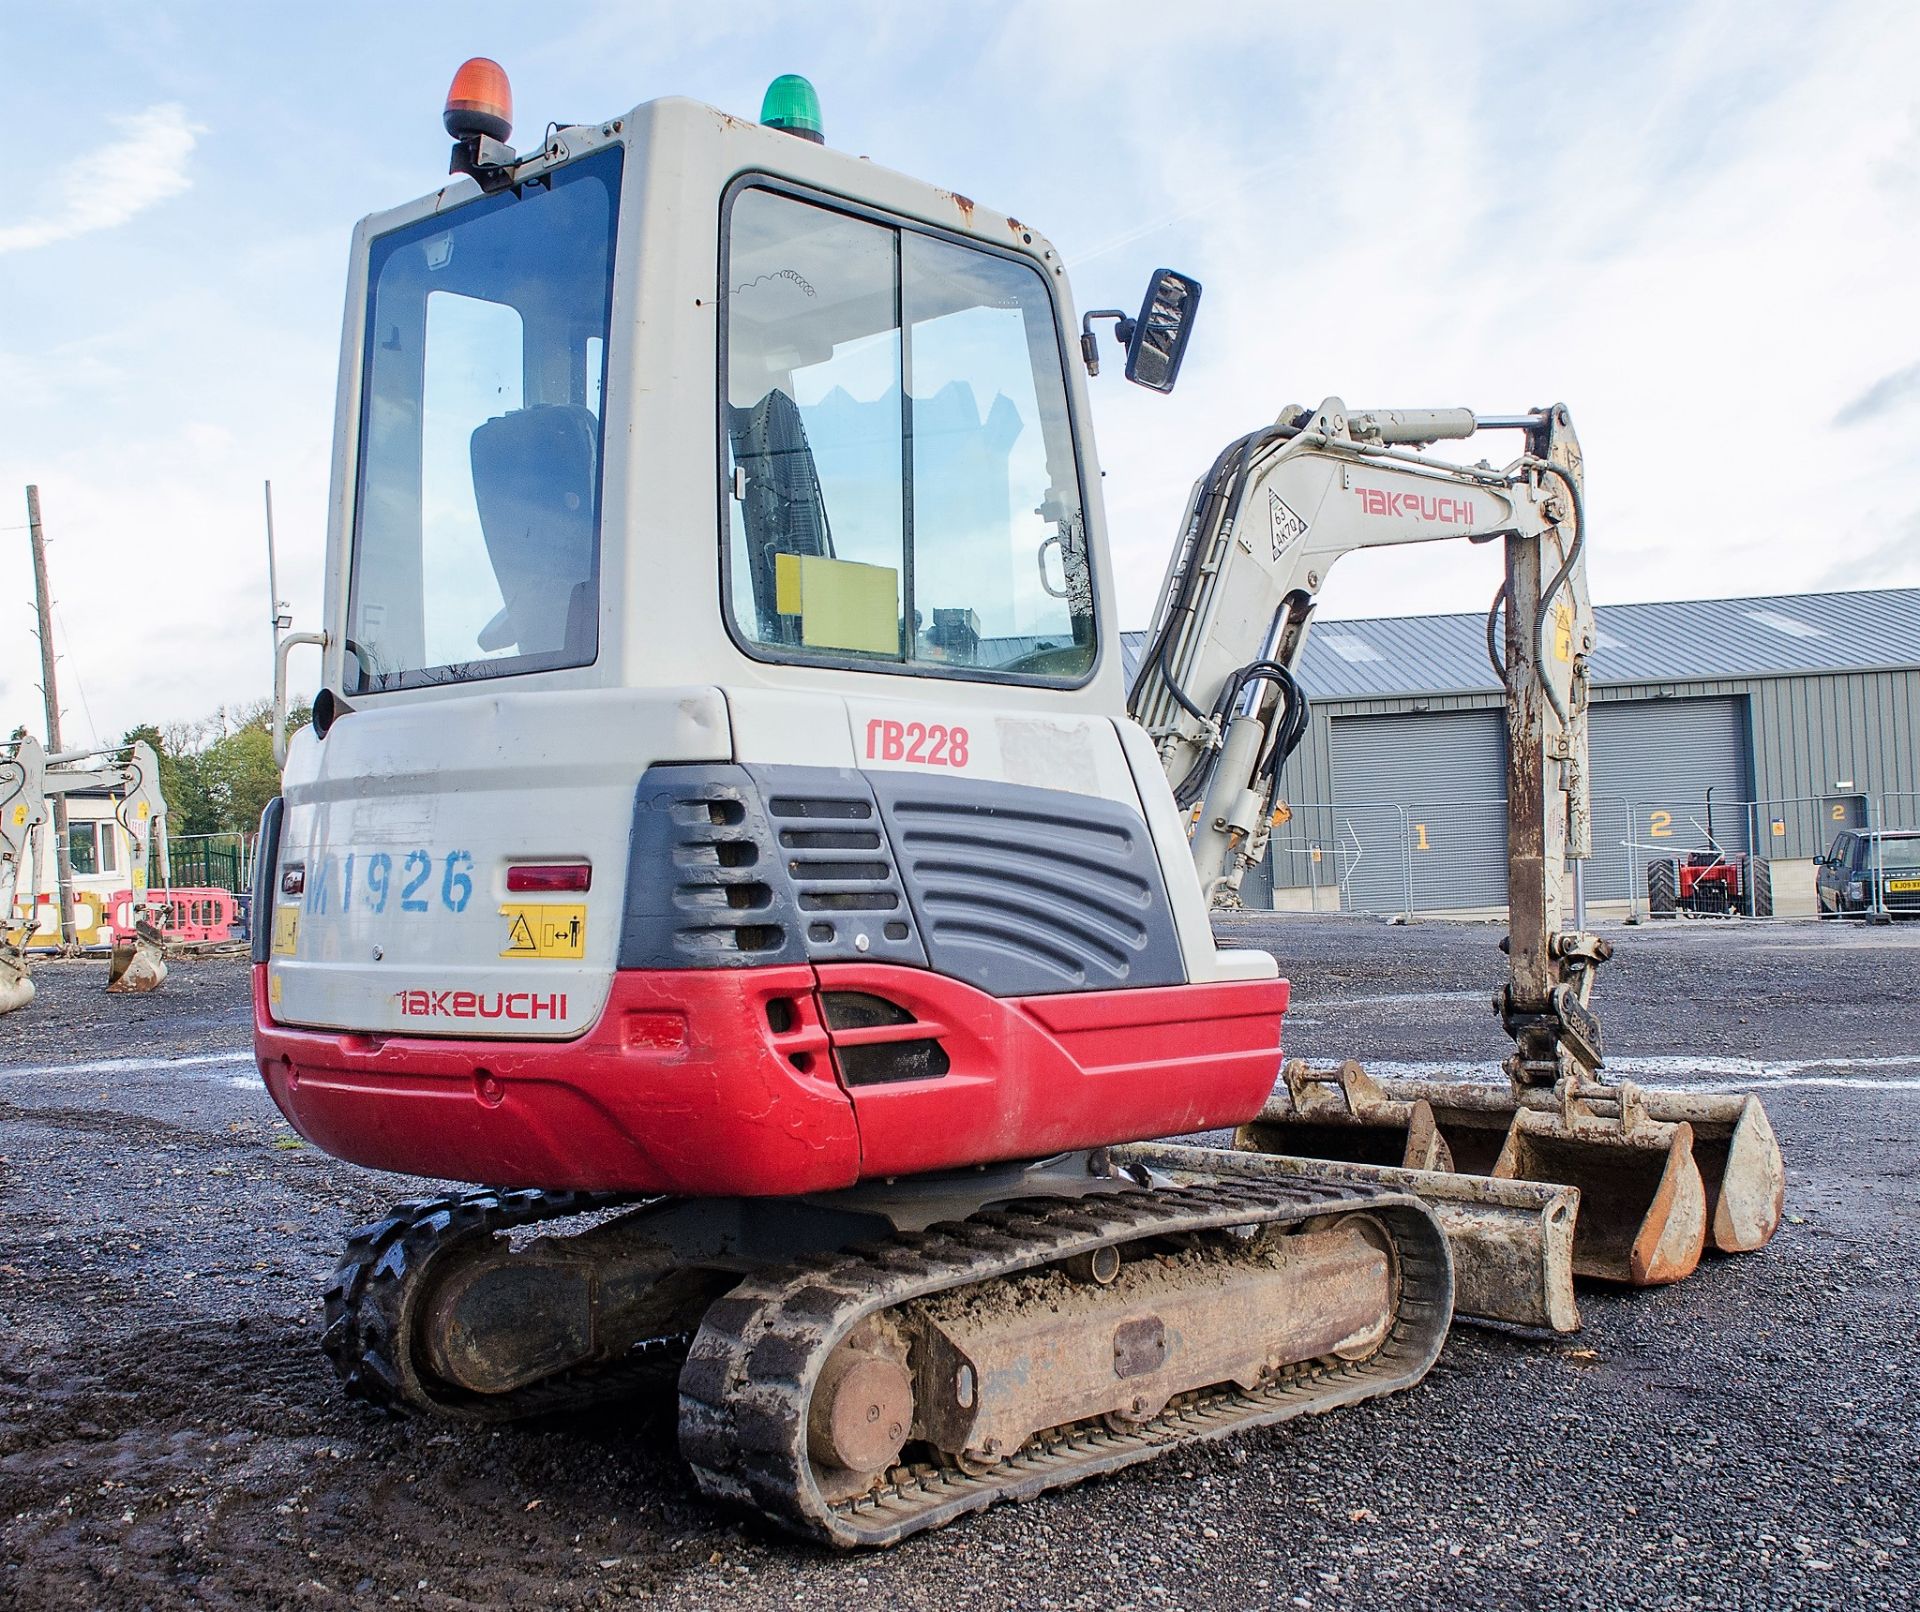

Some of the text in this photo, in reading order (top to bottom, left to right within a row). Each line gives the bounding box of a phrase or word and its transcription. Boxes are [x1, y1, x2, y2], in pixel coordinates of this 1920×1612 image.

[1274, 507, 1286, 525] 63
[1275, 518, 1298, 546] AK7Q
[866, 718, 969, 768] TB228
[1650, 810, 1673, 837] 2
[1832, 804, 1845, 820] 2
[1415, 823, 1430, 850] 1
